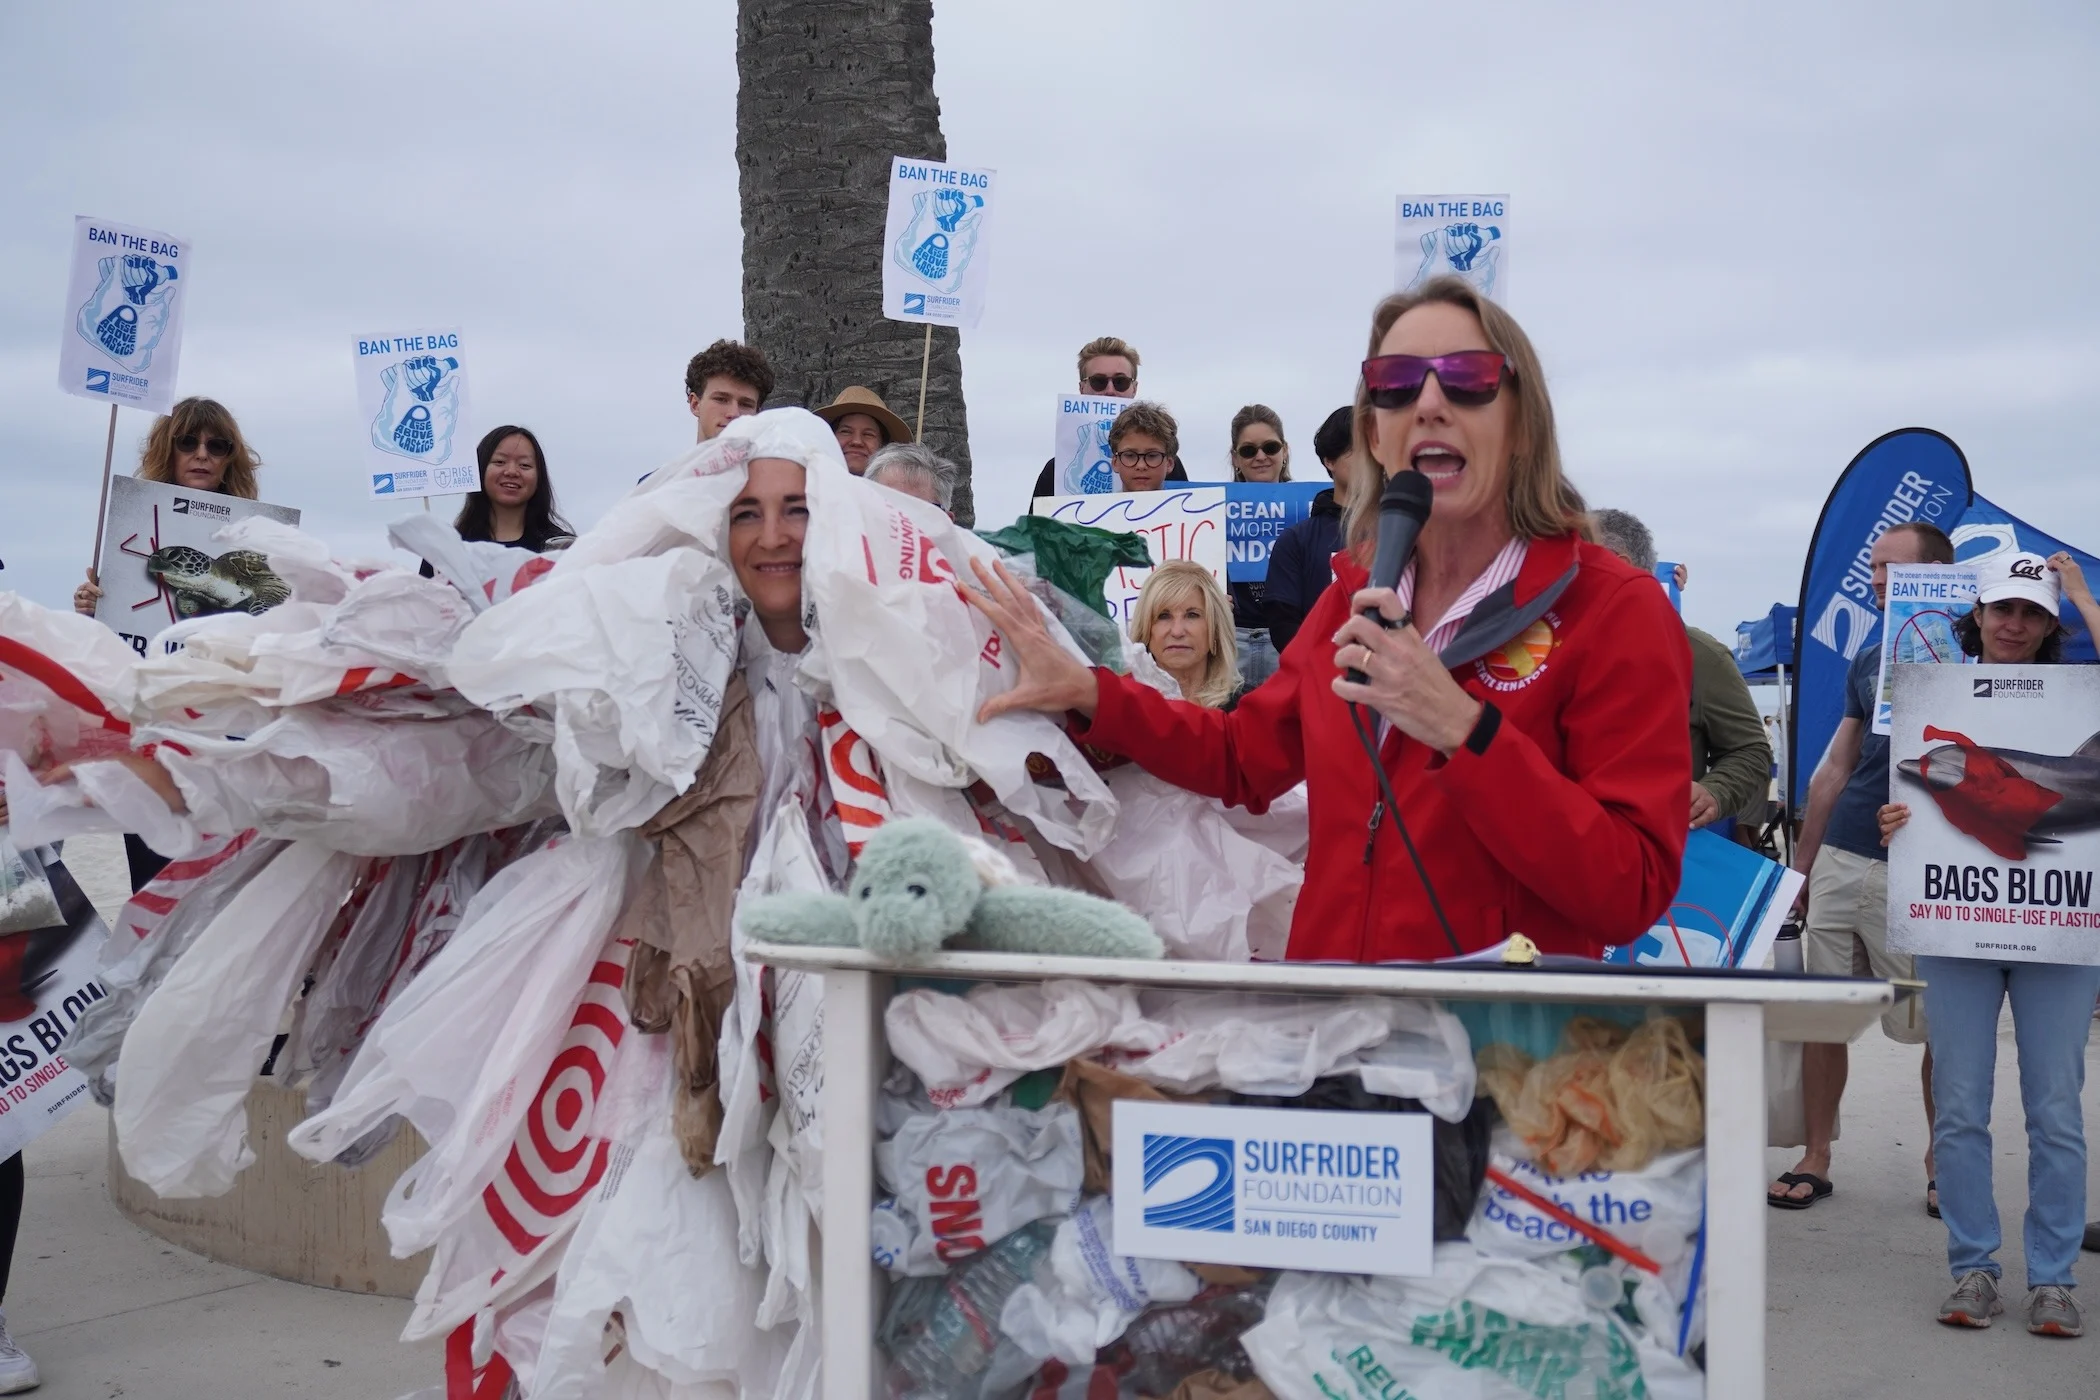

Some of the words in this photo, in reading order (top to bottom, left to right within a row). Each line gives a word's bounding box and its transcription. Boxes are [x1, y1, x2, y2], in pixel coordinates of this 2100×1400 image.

[899, 165, 927, 181] BAN
[931, 168, 957, 184] THE
[960, 172, 988, 188] BAG
[1402, 203, 1434, 218] BAN
[1438, 202, 1468, 217] THE
[1472, 202, 1504, 217] BAG
[89, 227, 117, 246] BAN
[121, 234, 147, 251] THE
[150, 240, 178, 258] BAG
[926, 295, 961, 306] SURFRIDER
[359, 340, 391, 356] BAN
[394, 337, 424, 352] THE
[427, 334, 458, 350] BAG
[111, 373, 149, 388] SURFRIDER
[1064, 400, 1090, 414] BAN
[1093, 402, 1117, 416] THE
[394, 470, 428, 480] SURFRIDER
[452, 466, 473, 477] RISE
[453, 476, 474, 485] ABOVE
[190, 500, 231, 516] SURFRIDER
[189, 510, 231, 523] FOUNDATION
[1230, 521, 1286, 537] MORE
[2008, 559, 2044, 580] Cal
[1892, 582, 1918, 596] BAN
[1922, 583, 1947, 598] THE
[1474, 660, 1497, 688] STATE
[1495, 664, 1548, 691] SENATOR
[1993, 679, 2044, 691] SURFRIDER
[1993, 690, 2044, 699] FOUNDATION
[1925, 864, 1999, 902] BAGS
[2008, 868, 2093, 908] BLOW
[1909, 903, 1931, 919] SAY
[1935, 904, 1952, 920] NO
[1955, 906, 1970, 922] TO
[1974, 907, 2046, 926] SINGLE-USE
[2050, 911, 2100, 929] PLASTIC
[1975, 942, 2037, 952] SURFRIDER.ORG
[6, 1085, 28, 1105] TO
[1243, 1139, 1400, 1180] SURFRIDER
[1243, 1178, 1402, 1208] FOUNDATION
[1589, 1192, 1653, 1225] the
[1243, 1218, 1271, 1237] SAN
[1276, 1220, 1318, 1240] DIEGO
[1322, 1223, 1378, 1243] COUNTY
